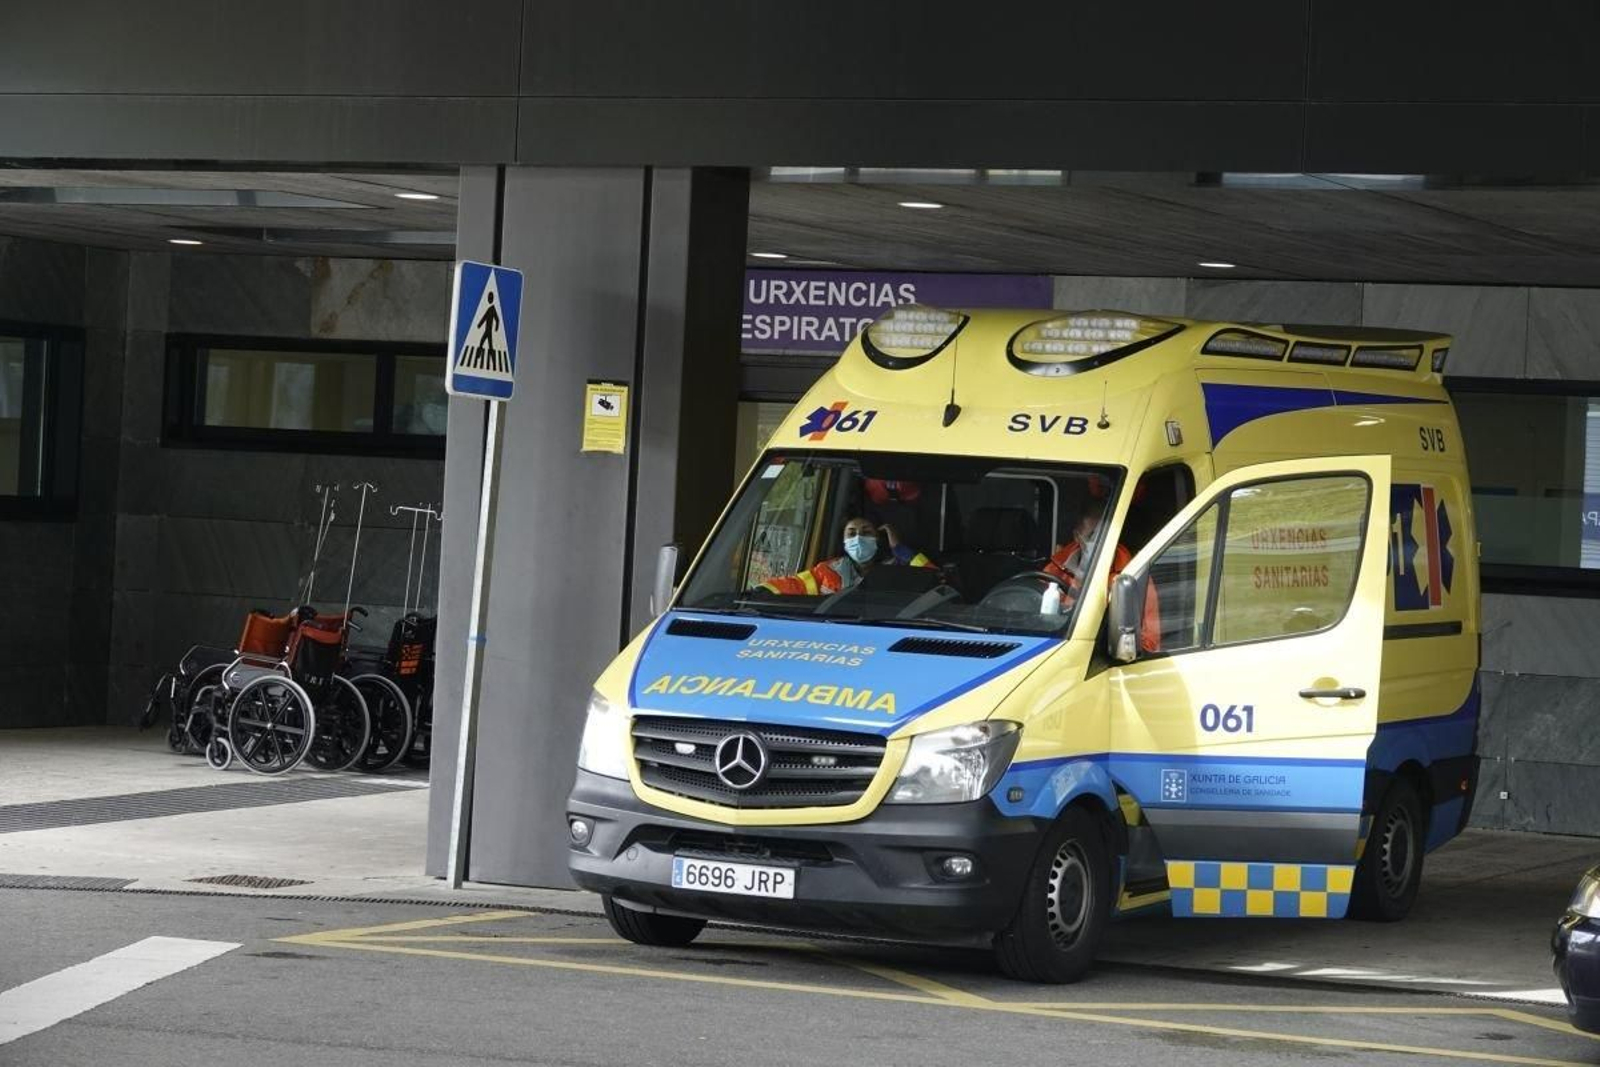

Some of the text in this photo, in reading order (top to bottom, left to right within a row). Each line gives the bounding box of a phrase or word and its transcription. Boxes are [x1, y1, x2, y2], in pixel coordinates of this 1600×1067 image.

[748, 279, 917, 307] URXENCIAS
[820, 409, 878, 433] 061
[1008, 413, 1089, 435] SVB
[1419, 426, 1446, 452] SVB
[1251, 528, 1327, 550] URXENCIAS
[1254, 565, 1329, 589] SANITARIAS
[737, 650, 864, 667] SANITARIAS
[749, 638, 876, 655] URXENCIAS
[1200, 703, 1254, 733] 061
[1191, 774, 1286, 785] XUNTA DE GALICIA
[685, 863, 785, 893] 6696 JRP
